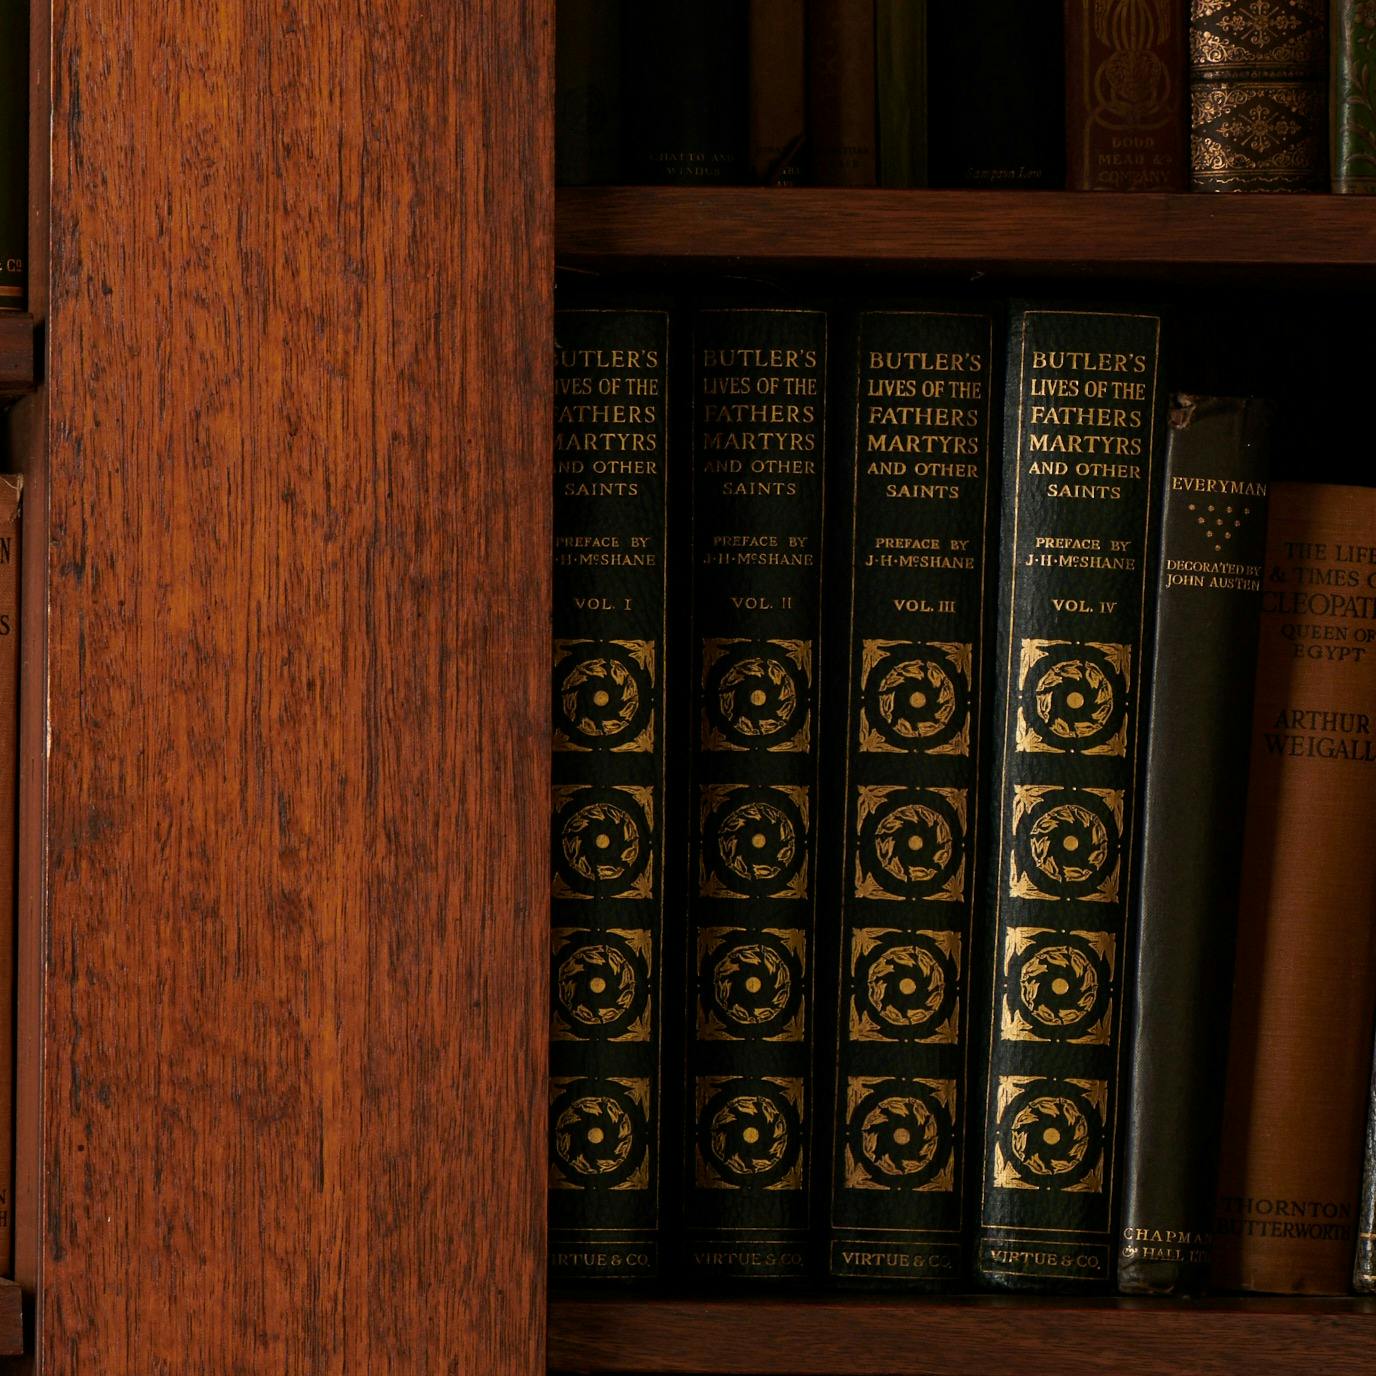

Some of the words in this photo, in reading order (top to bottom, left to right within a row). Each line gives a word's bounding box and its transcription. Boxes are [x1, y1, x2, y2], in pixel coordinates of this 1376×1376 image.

[1033, 352, 1146, 373] BUTLER'S
[1031, 379, 1079, 397] LIVES
[1085, 381, 1107, 398] OF
[1112, 382, 1146, 400] THE
[1030, 406, 1141, 428] FATHERS
[1029, 434, 1141, 455] MARTYRS
[1029, 462, 1068, 475] AND
[1075, 463, 1140, 479] OTHER
[1048, 484, 1121, 499] SAINTS
[1172, 477, 1267, 496] EVERYMAN
[1167, 559, 1245, 575] DECORATED
[1166, 573, 1204, 589] JOHN
[1209, 576, 1261, 591] AUSTEN
[1051, 600, 1093, 612] VOL.
[1100, 602, 1116, 613] IV
